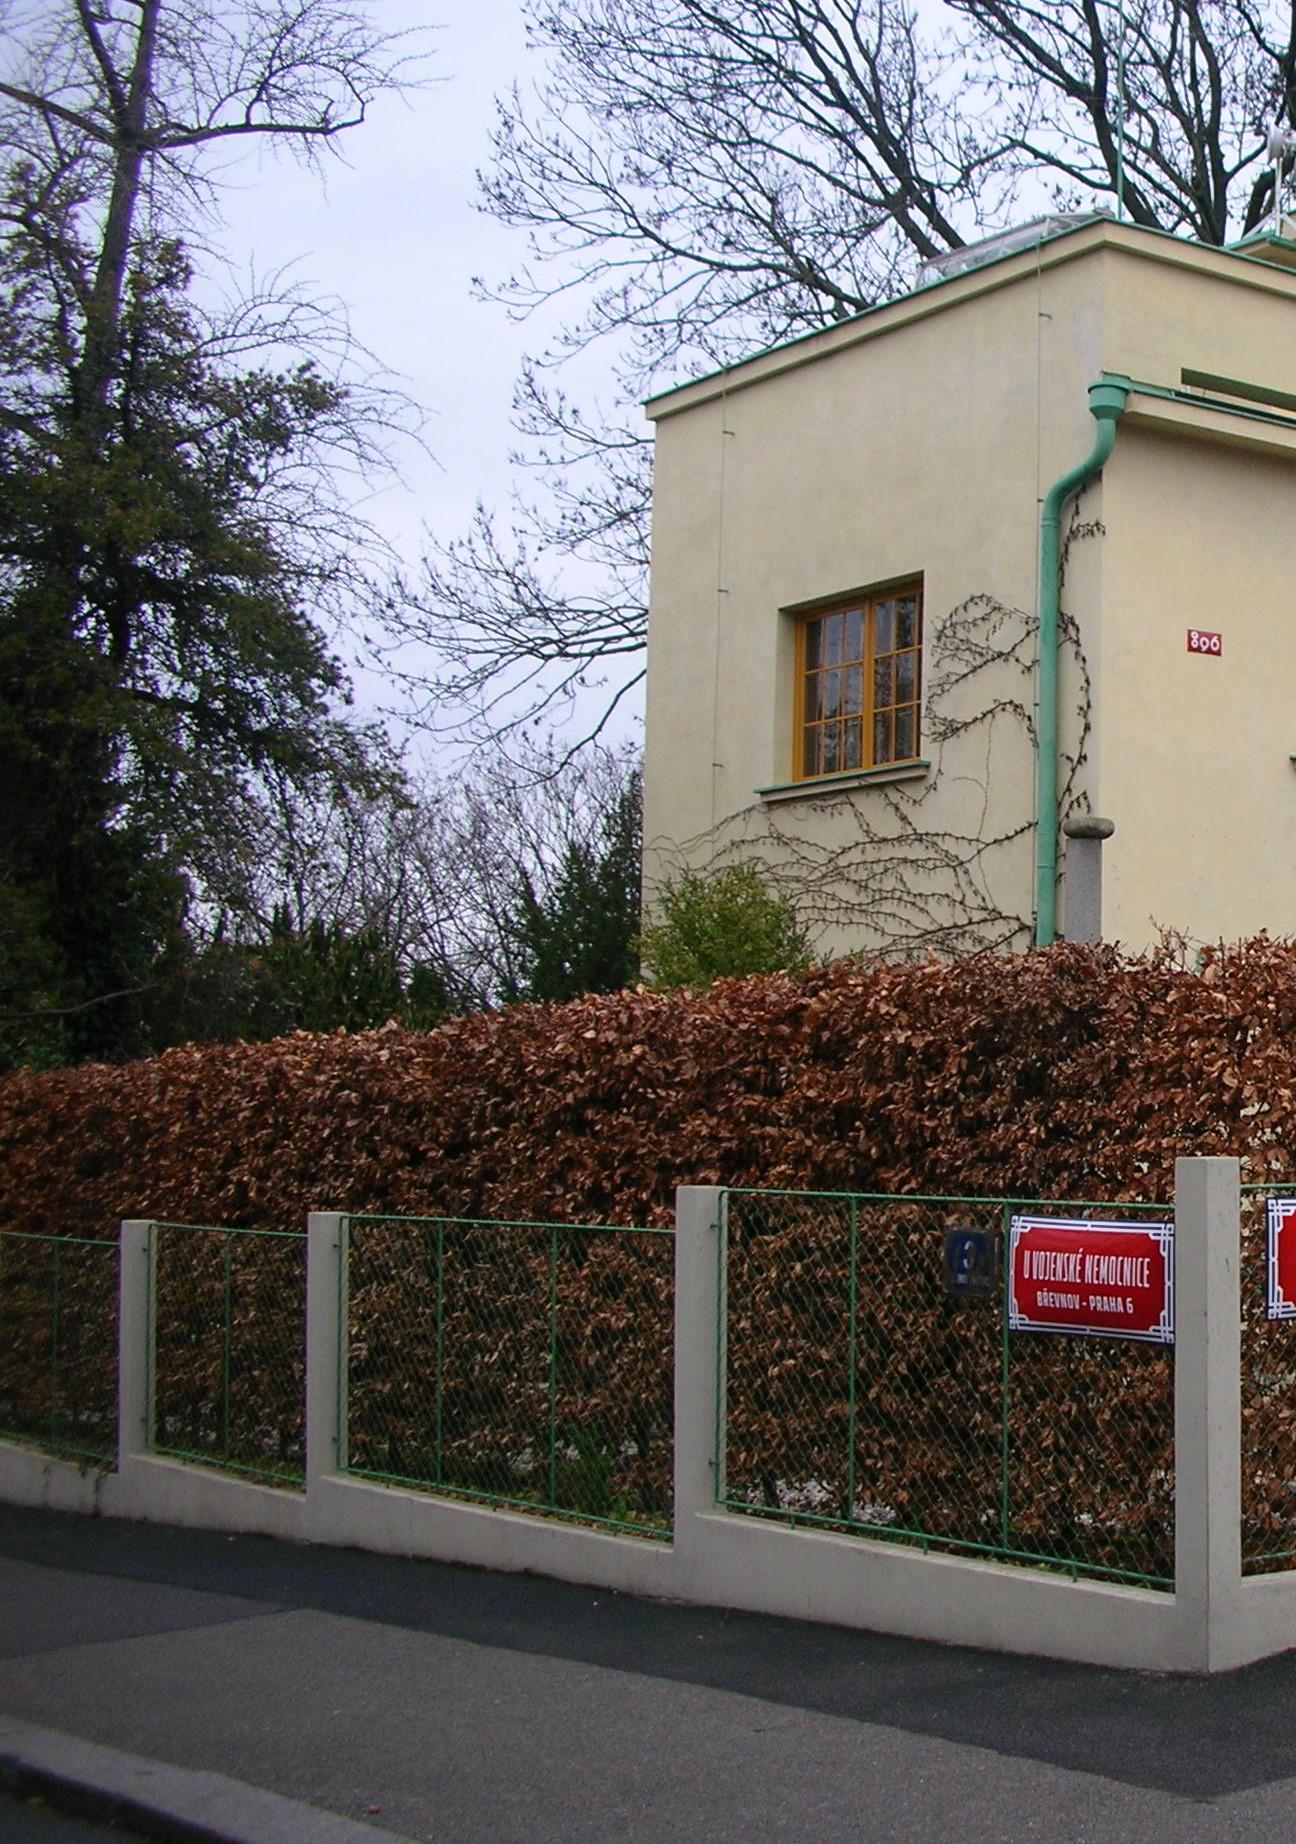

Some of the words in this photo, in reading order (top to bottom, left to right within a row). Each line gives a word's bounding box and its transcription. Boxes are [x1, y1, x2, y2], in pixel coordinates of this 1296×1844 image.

[1023, 1249, 1032, 1279] U
[1032, 1247, 1084, 1283] VOJENSKÉ
[1084, 1254, 1151, 1288] NEMOCNICE
[1036, 1287, 1081, 1310] BŘEVNOV
[1089, 1295, 1124, 1313] PRAHA
[1125, 1297, 1134, 1314] 6
